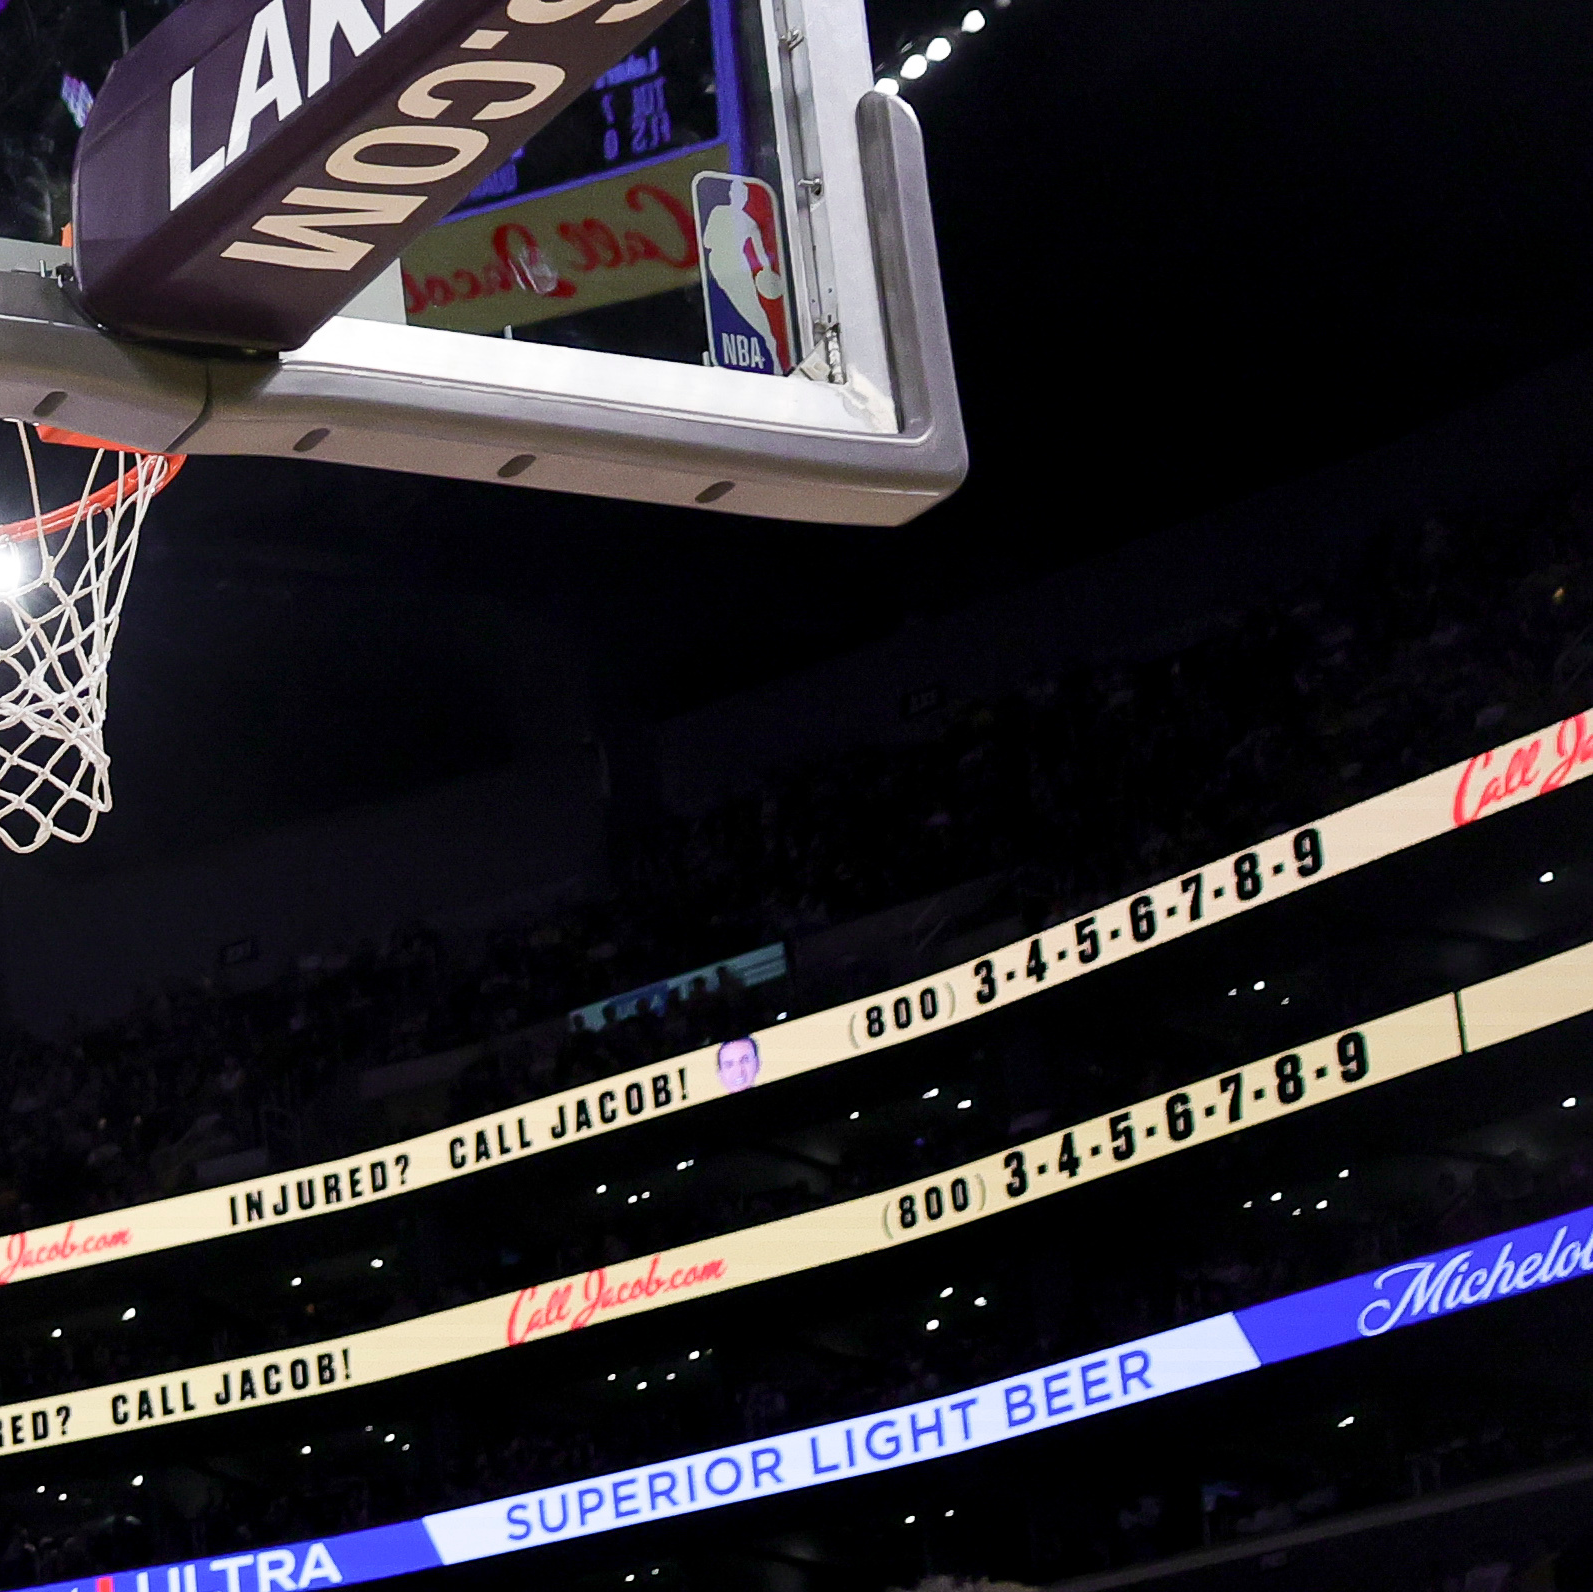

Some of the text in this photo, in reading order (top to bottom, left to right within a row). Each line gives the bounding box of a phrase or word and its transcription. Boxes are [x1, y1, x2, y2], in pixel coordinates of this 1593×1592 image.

[721, 332, 764, 369] NBA
[1453, 739, 1543, 828] Call
[229, 1066, 689, 1228] INJURED? CALL JACOB!
[506, 1252, 728, 1347] Call Jacob.com
[111, 1380, 197, 1427] CALL
[214, 1347, 352, 1407] JACOB!
[506, 1350, 1154, 1541] SUPERIOR LIGHT BEER
